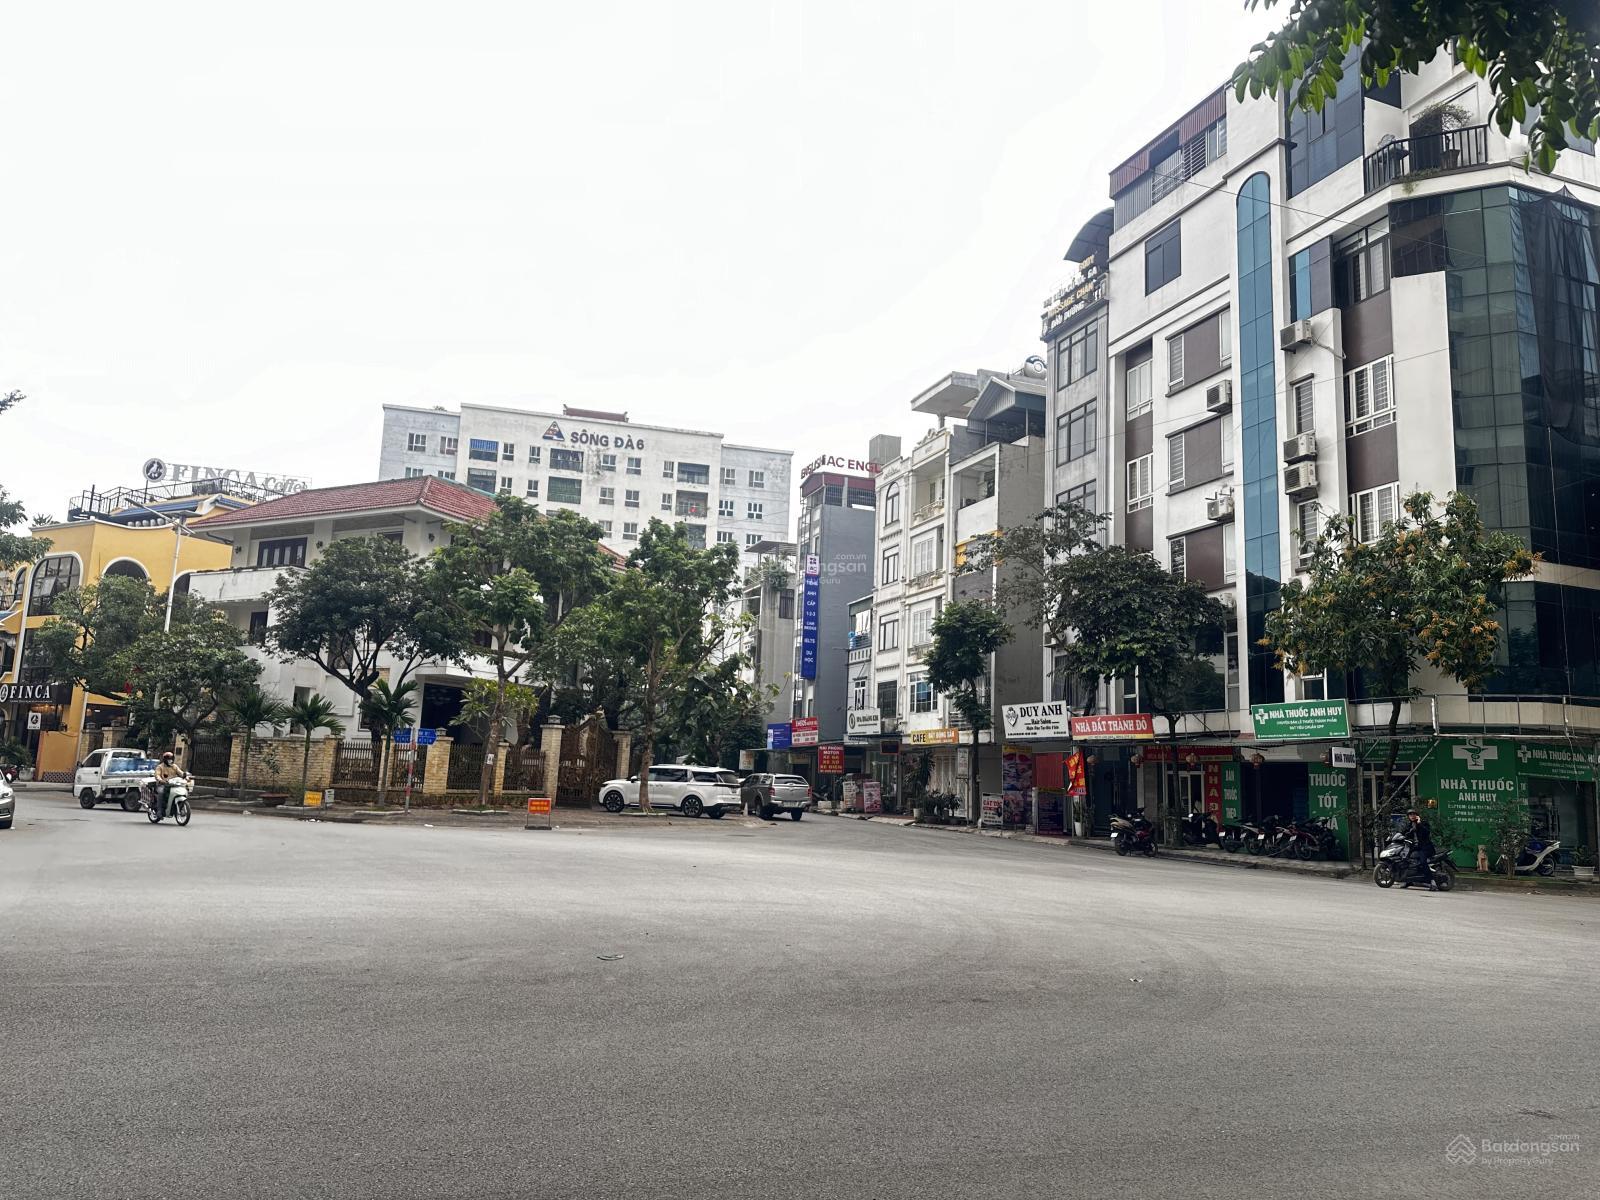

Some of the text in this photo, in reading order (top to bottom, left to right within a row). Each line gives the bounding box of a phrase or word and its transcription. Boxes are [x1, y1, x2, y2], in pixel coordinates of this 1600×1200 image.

[570, 429, 609, 447] SÔNG
[827, 456, 845, 468] AC
[172, 464, 258, 488] FINCA
[9, 685, 51, 699] FINCA
[1020, 704, 1063, 718] DUY ANH
[1269, 705, 1343, 719] NHÀ THUỐC ANH HUY
[1075, 719, 1091, 733] NHÀ
[1092, 717, 1107, 732] ĐẤT
[1108, 718, 1135, 732] THÀNH
[913, 733, 926, 742] CAFE
[1309, 769, 1346, 786] THUỐC
[1440, 777, 1514, 791] NHÀ THUỐC
[1318, 790, 1338, 809] TỐT
[1458, 792, 1497, 802] ANH HUY
